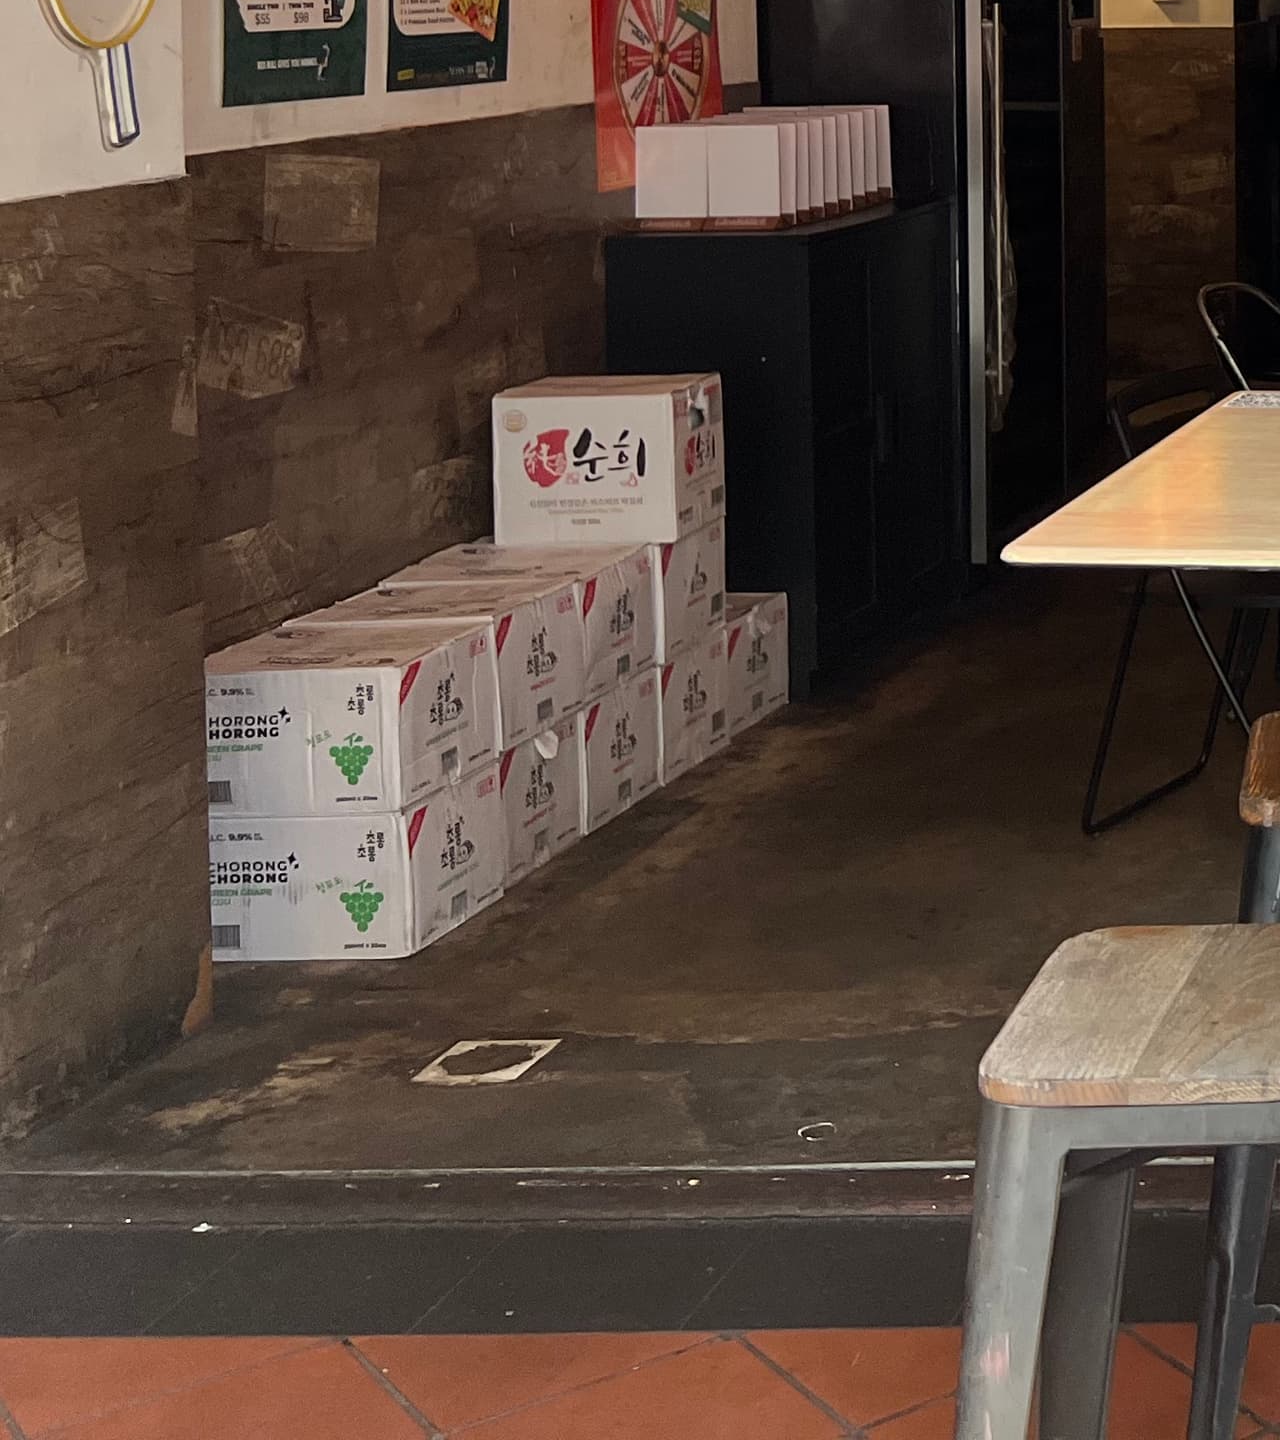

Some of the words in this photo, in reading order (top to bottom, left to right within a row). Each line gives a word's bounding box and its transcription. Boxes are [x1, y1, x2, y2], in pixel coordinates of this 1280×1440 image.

[573, 427, 646, 482] 순희
[208, 715, 279, 728] HORONG
[208, 727, 279, 740] HORONG
[211, 888, 239, 897] REEN
